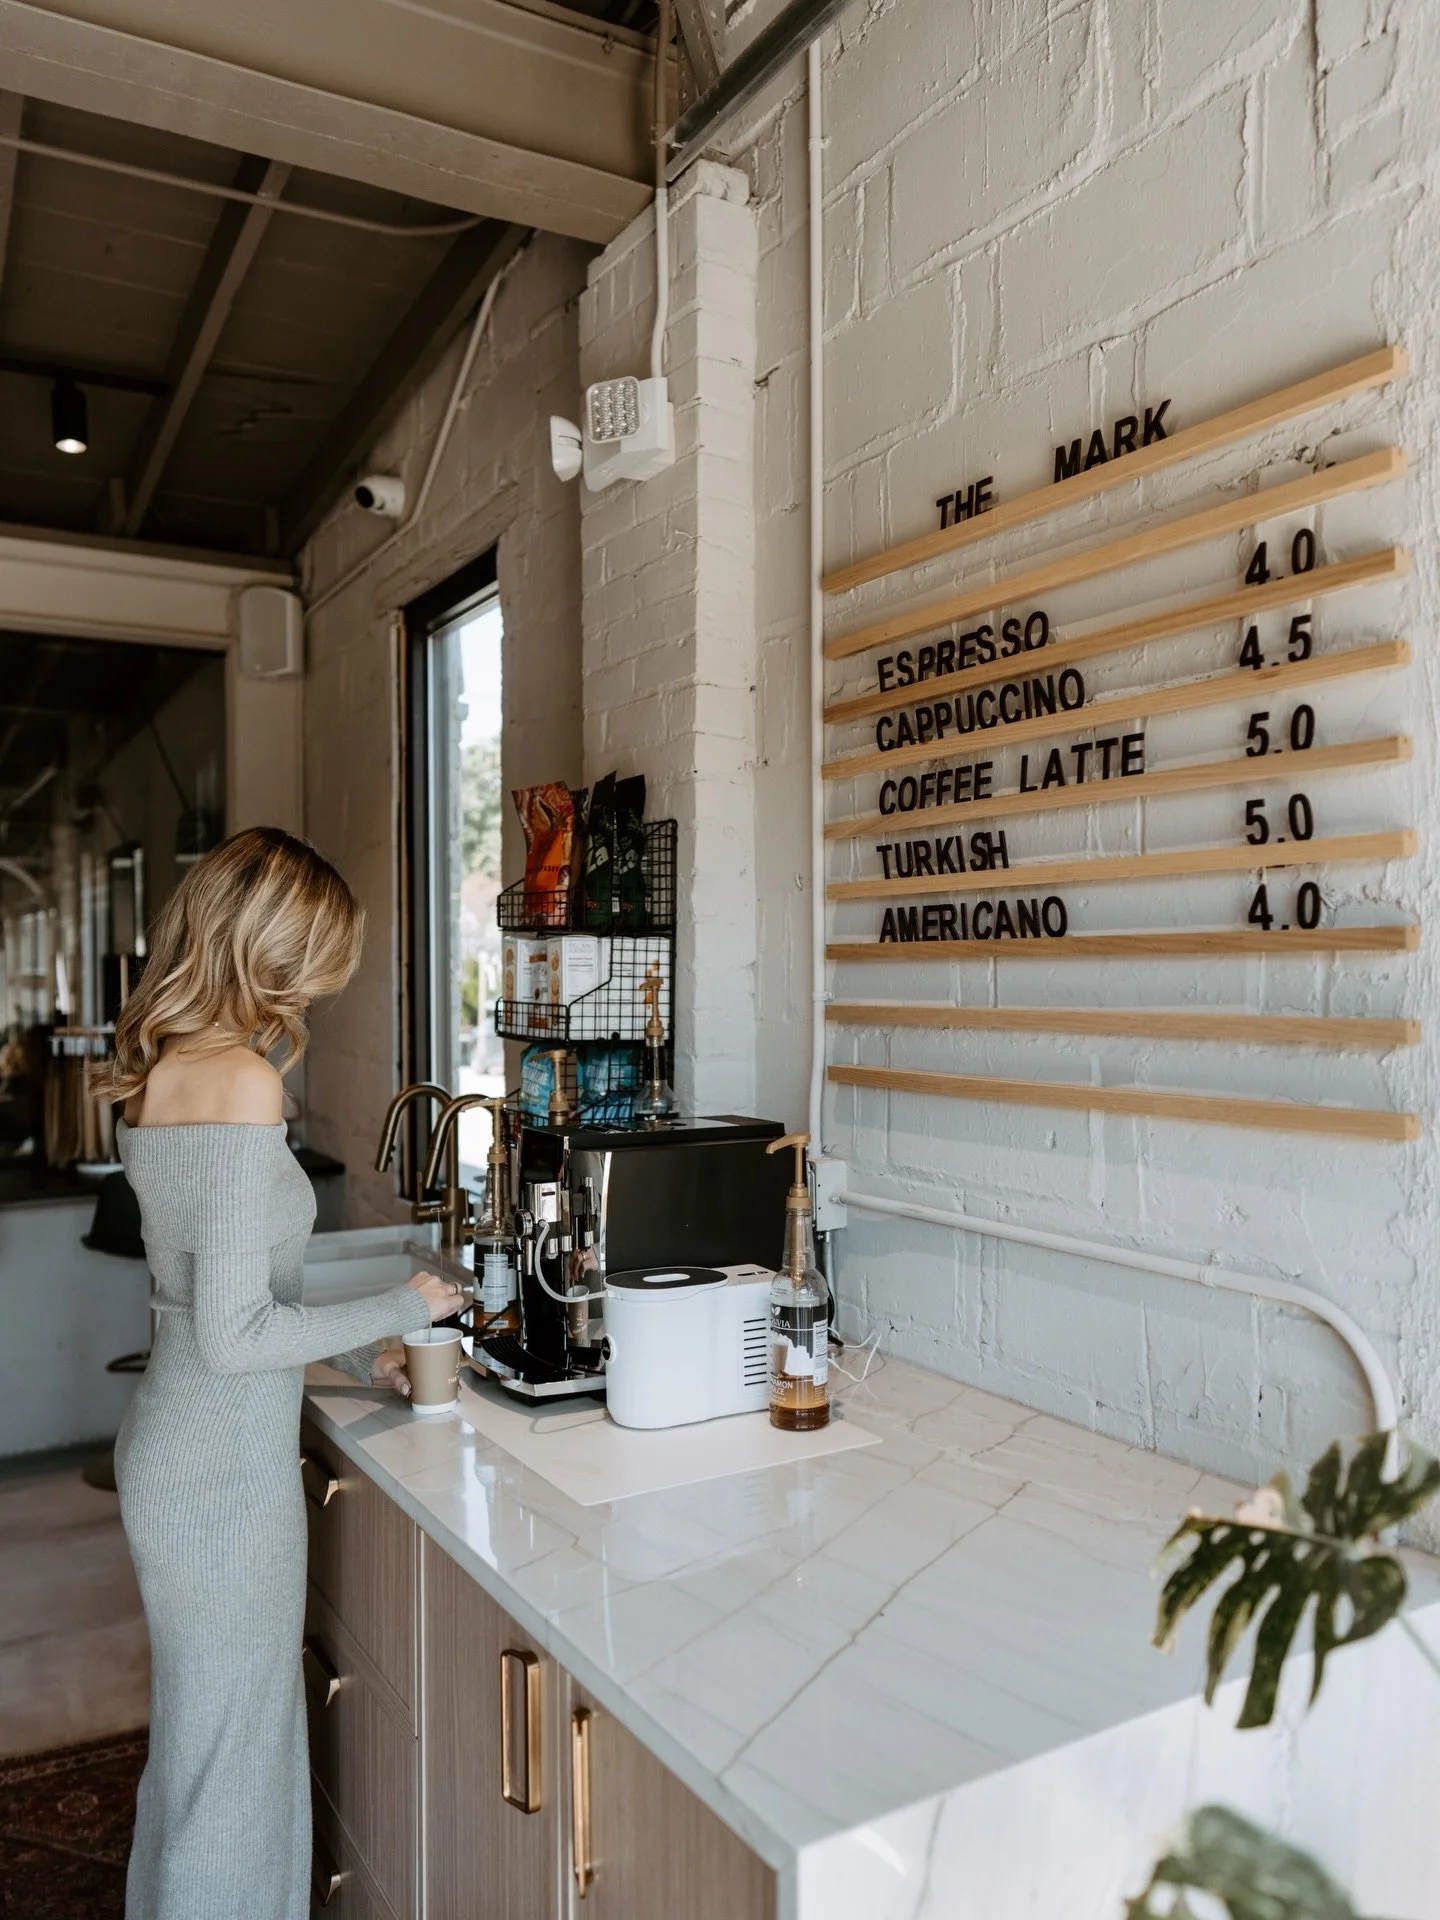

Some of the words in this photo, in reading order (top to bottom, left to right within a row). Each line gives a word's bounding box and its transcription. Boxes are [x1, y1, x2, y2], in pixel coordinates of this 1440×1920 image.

[936, 476, 993, 530] THE
[1053, 400, 1172, 483] MARK
[877, 611, 1048, 692] ESPRESSO
[1245, 528, 1316, 585] 4.0
[876, 668, 1085, 752] CAPPUCCINO
[1240, 614, 1312, 670] 4.5
[879, 761, 993, 815] COFFEE
[1020, 733, 1145, 793] LATTE
[1246, 704, 1315, 757] 5.0
[876, 830, 1009, 879] TURKISH
[1246, 793, 1313, 845] 5.0
[879, 896, 1068, 943] AMERICANO
[1248, 882, 1321, 930] 4.0
